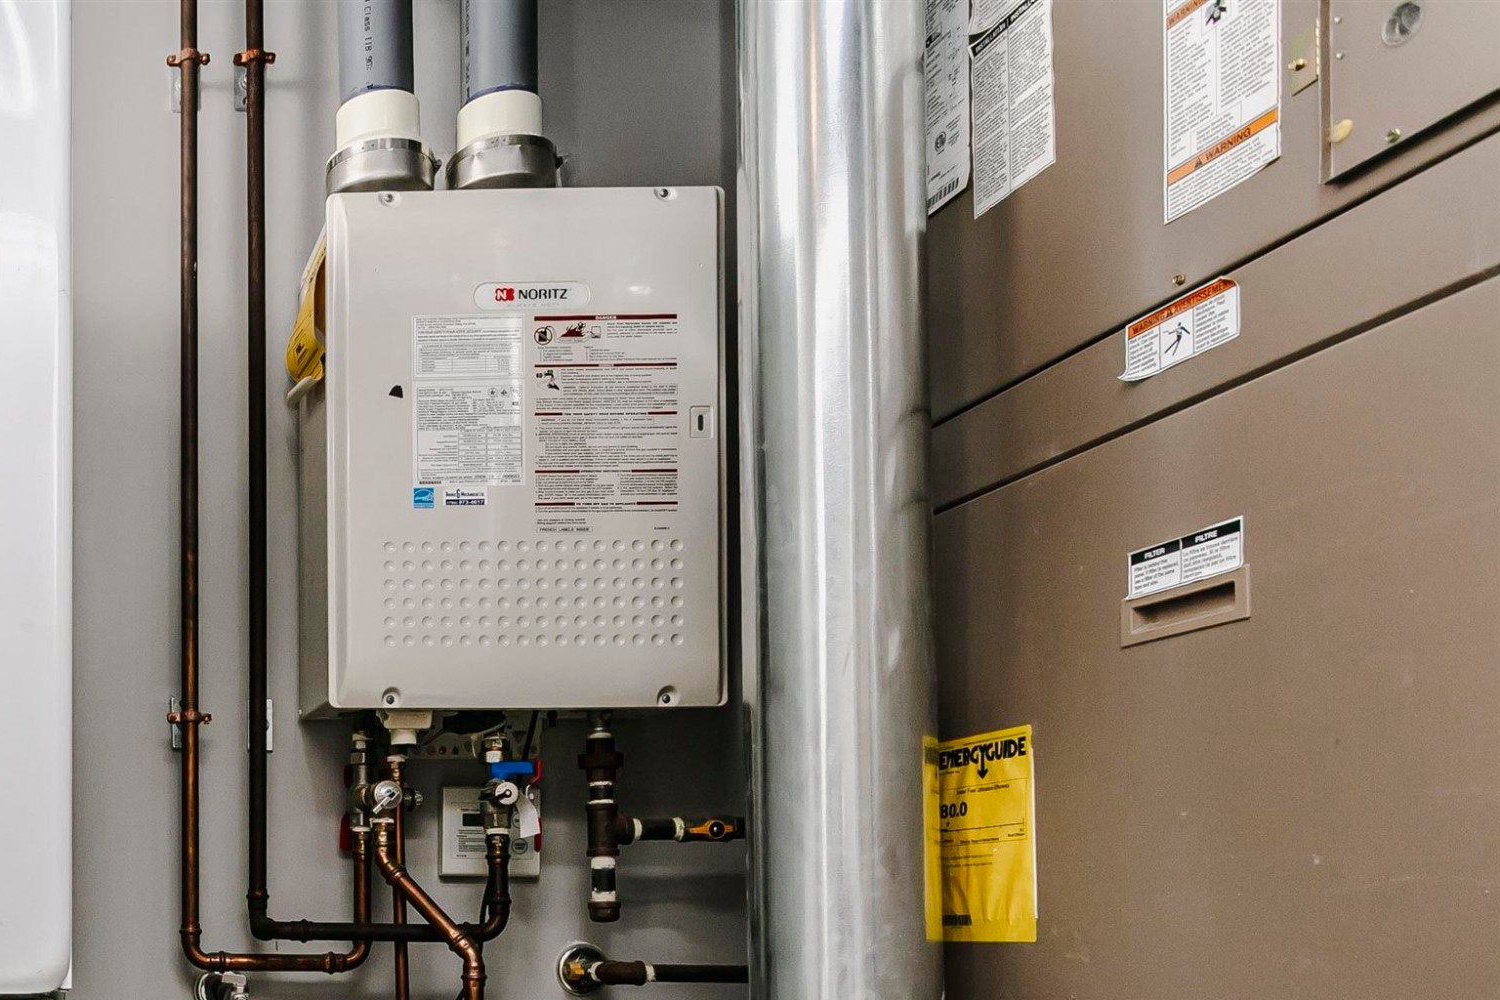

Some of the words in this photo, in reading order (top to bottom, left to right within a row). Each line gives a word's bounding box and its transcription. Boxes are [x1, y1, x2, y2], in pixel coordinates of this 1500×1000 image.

[1205, 127, 1251, 161] WARNING
[518, 288, 568, 300] NORITZ
[1195, 530, 1217, 543] FILTRE
[1145, 548, 1165, 559] FILTER
[941, 801, 968, 819] 80.0
